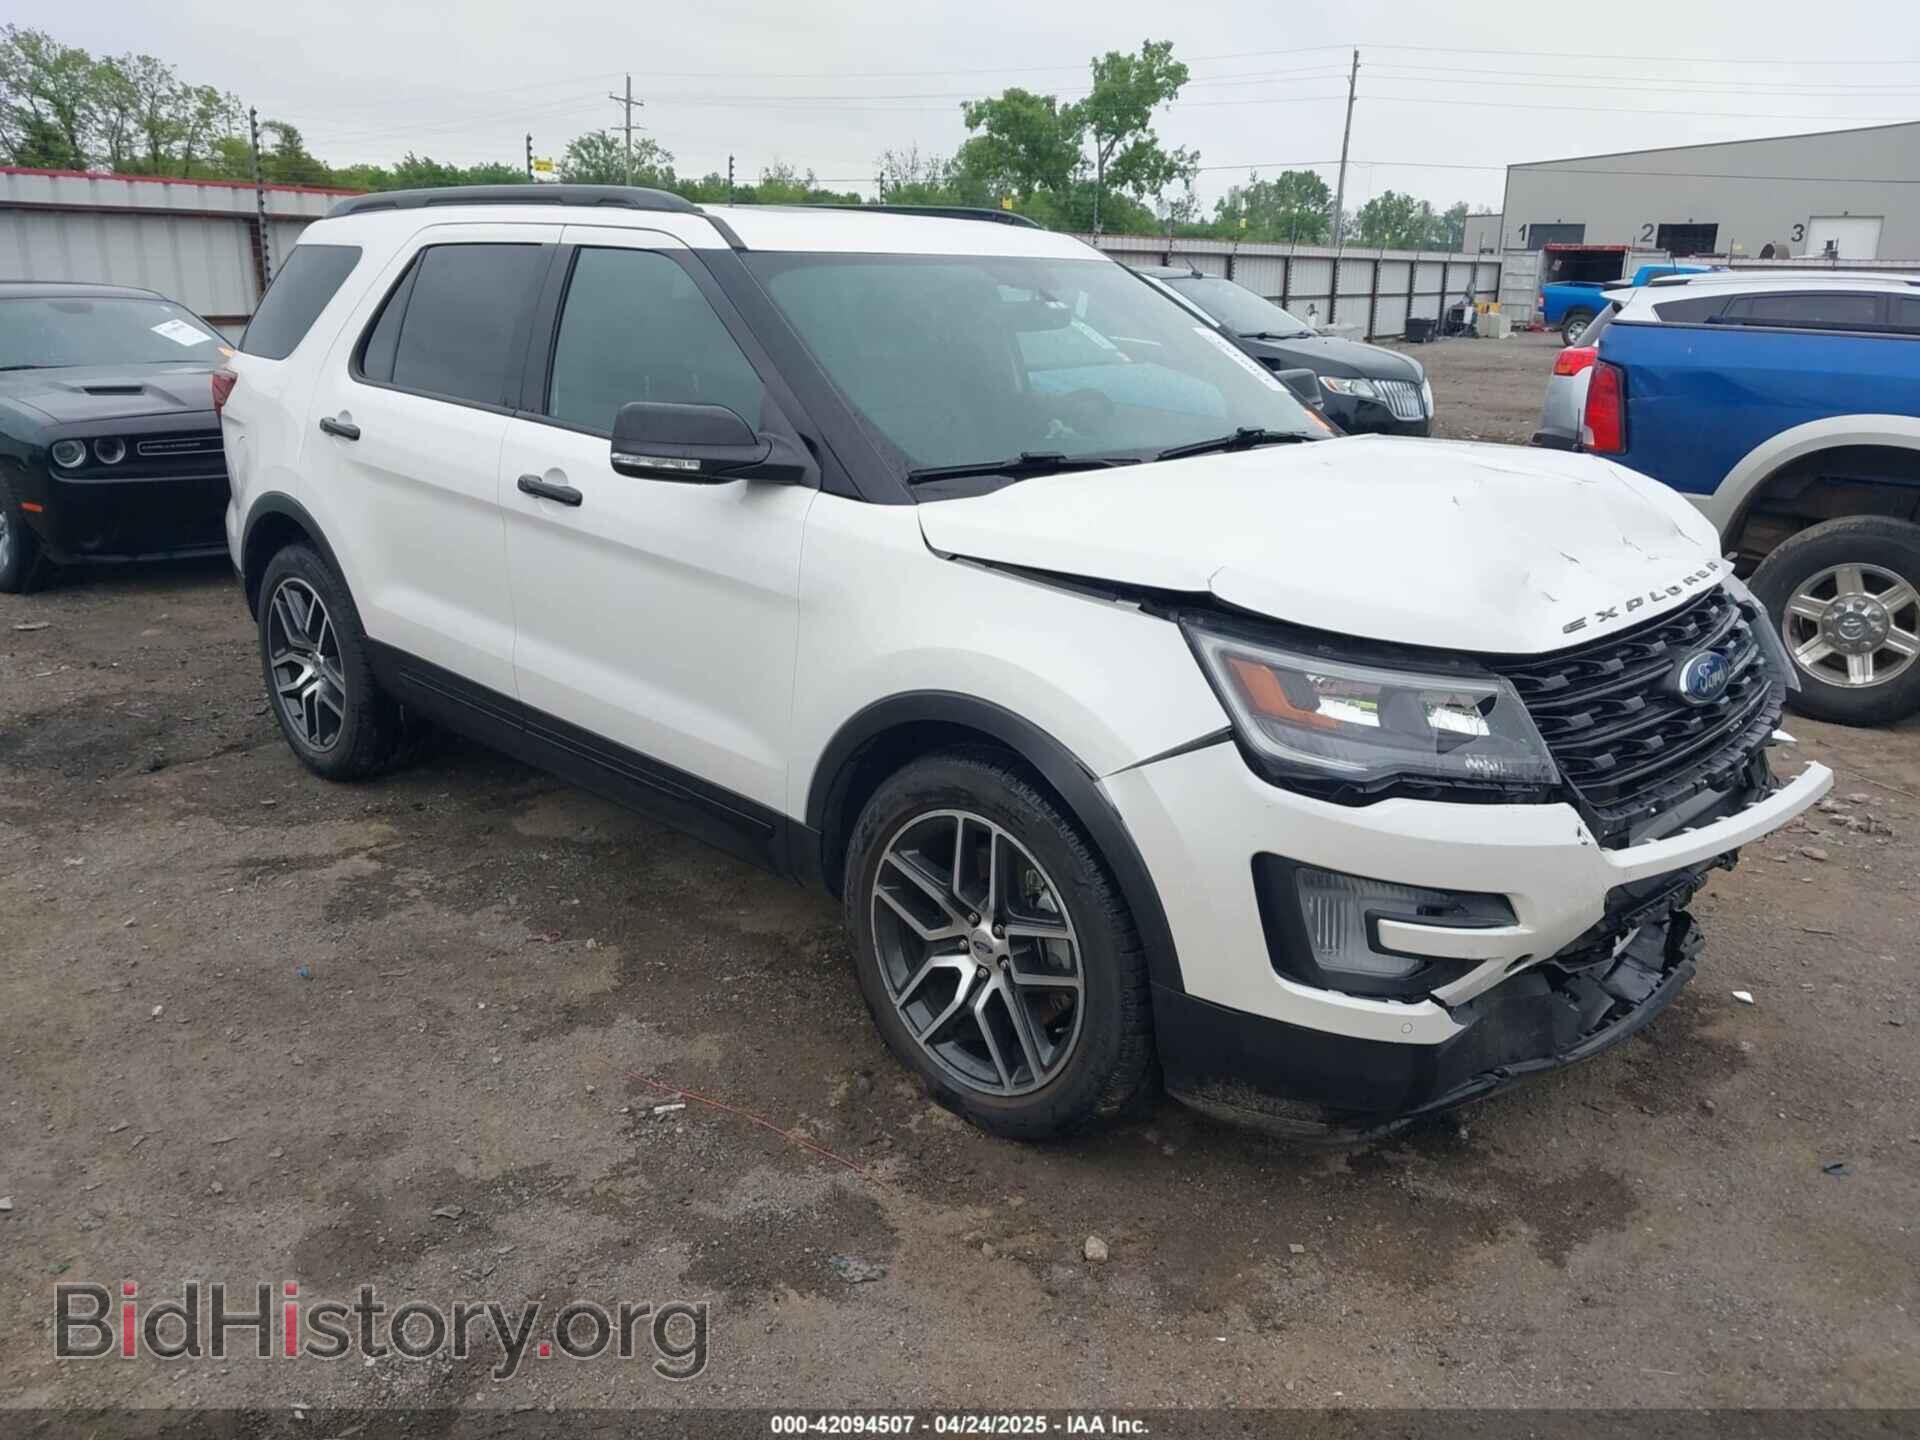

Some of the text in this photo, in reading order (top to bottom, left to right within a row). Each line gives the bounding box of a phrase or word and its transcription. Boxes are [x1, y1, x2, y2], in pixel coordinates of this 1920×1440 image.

[1518, 224, 1527, 241] 1
[1640, 223, 1655, 242] 2
[1791, 223, 1805, 242] 3
[1562, 561, 1719, 634] EXPLORER
